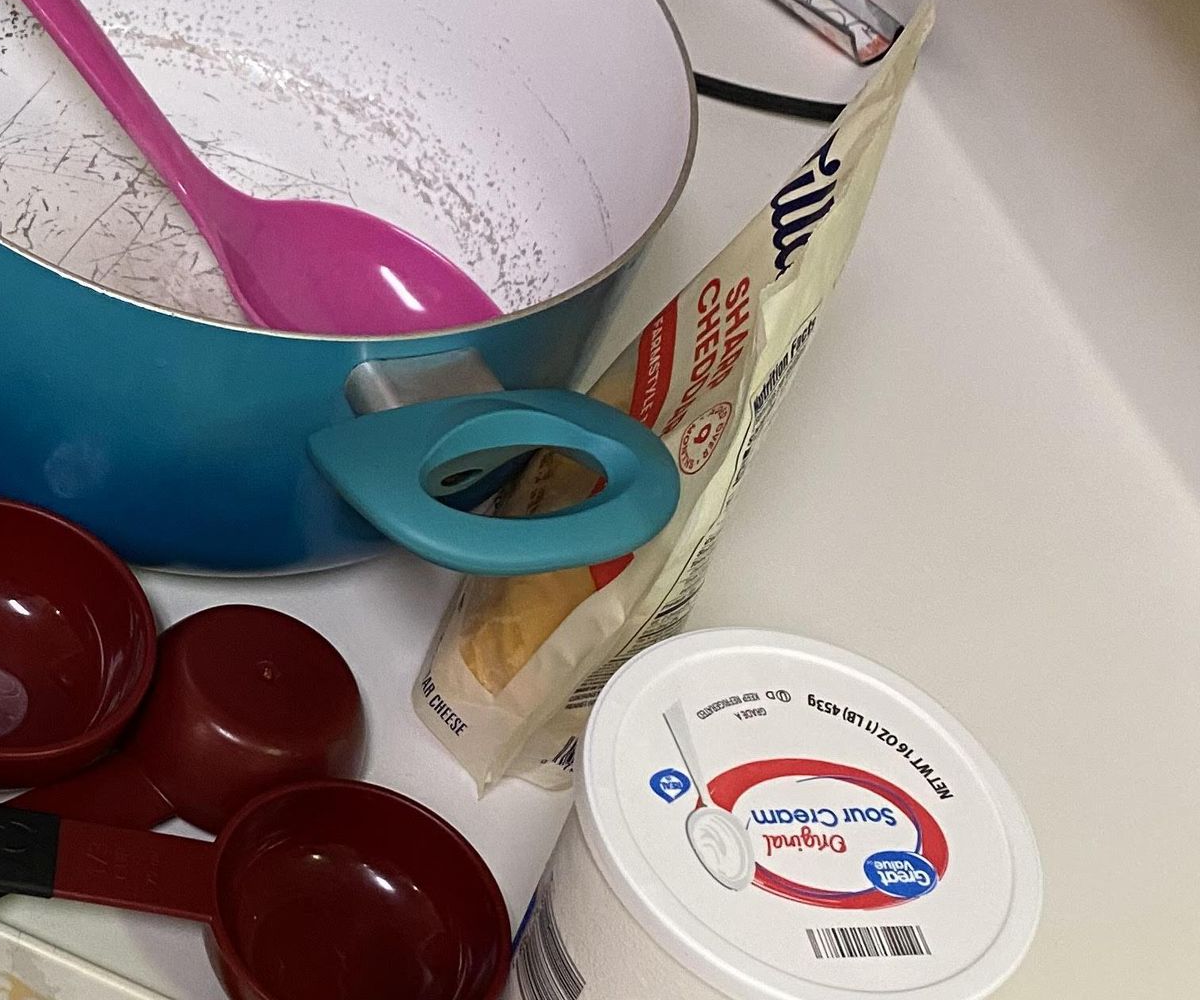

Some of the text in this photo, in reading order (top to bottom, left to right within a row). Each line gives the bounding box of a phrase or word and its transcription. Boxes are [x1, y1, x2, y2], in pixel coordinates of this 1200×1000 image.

[706, 276, 750, 390] SHARP
[693, 422, 712, 445] 9
[742, 691, 761, 703] KEEP
[428, 694, 468, 737] CHEESE
[733, 707, 767, 721] GRADE A
[807, 693, 954, 800] NET WT 16 OZ (1 LB) 453g
[751, 806, 898, 828] Sour Cream
[762, 825, 848, 857] Original
[873, 860, 913, 871] Value
[877, 869, 931, 887] Great
